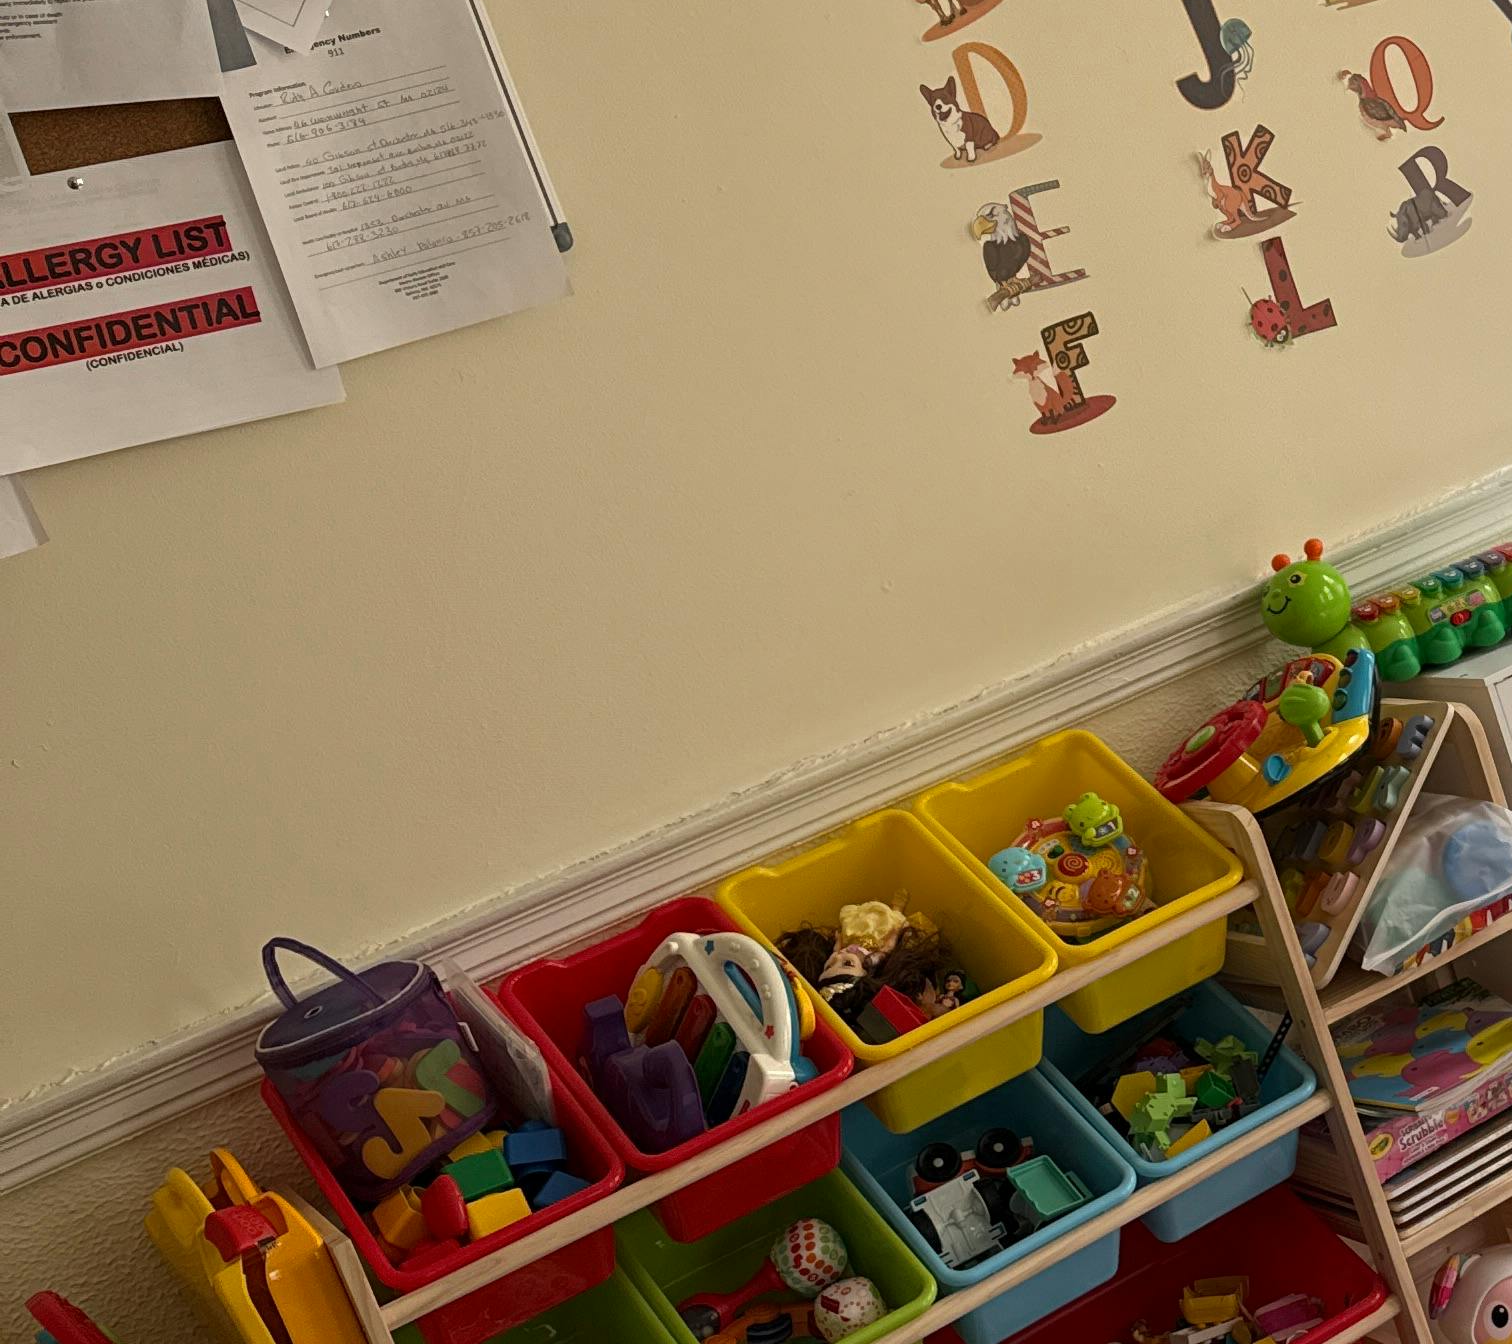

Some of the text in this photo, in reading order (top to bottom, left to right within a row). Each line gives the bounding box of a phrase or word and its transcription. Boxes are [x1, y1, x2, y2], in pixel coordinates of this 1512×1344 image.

[327, 48, 344, 57] 911
[338, 27, 381, 42] Numbers
[952, 41, 1028, 141] D
[1369, 36, 1446, 132] Q
[1221, 124, 1293, 210] K
[1398, 145, 1472, 212] R
[0, 220, 226, 290] LLERGY LIST
[1009, 180, 1089, 290] E
[12, 292, 30, 305] DE
[31, 281, 94, 302] ALERGIAS
[96, 281, 104, 289] o
[106, 262, 190, 287] CONDICIONES
[192, 250, 250, 269] MÉDICAS)
[1261, 236, 1338, 339] L
[0, 294, 261, 368] CONFIDENTIAL
[86, 341, 184, 372] (CONFIDENCIAL)
[1040, 311, 1100, 411] F
